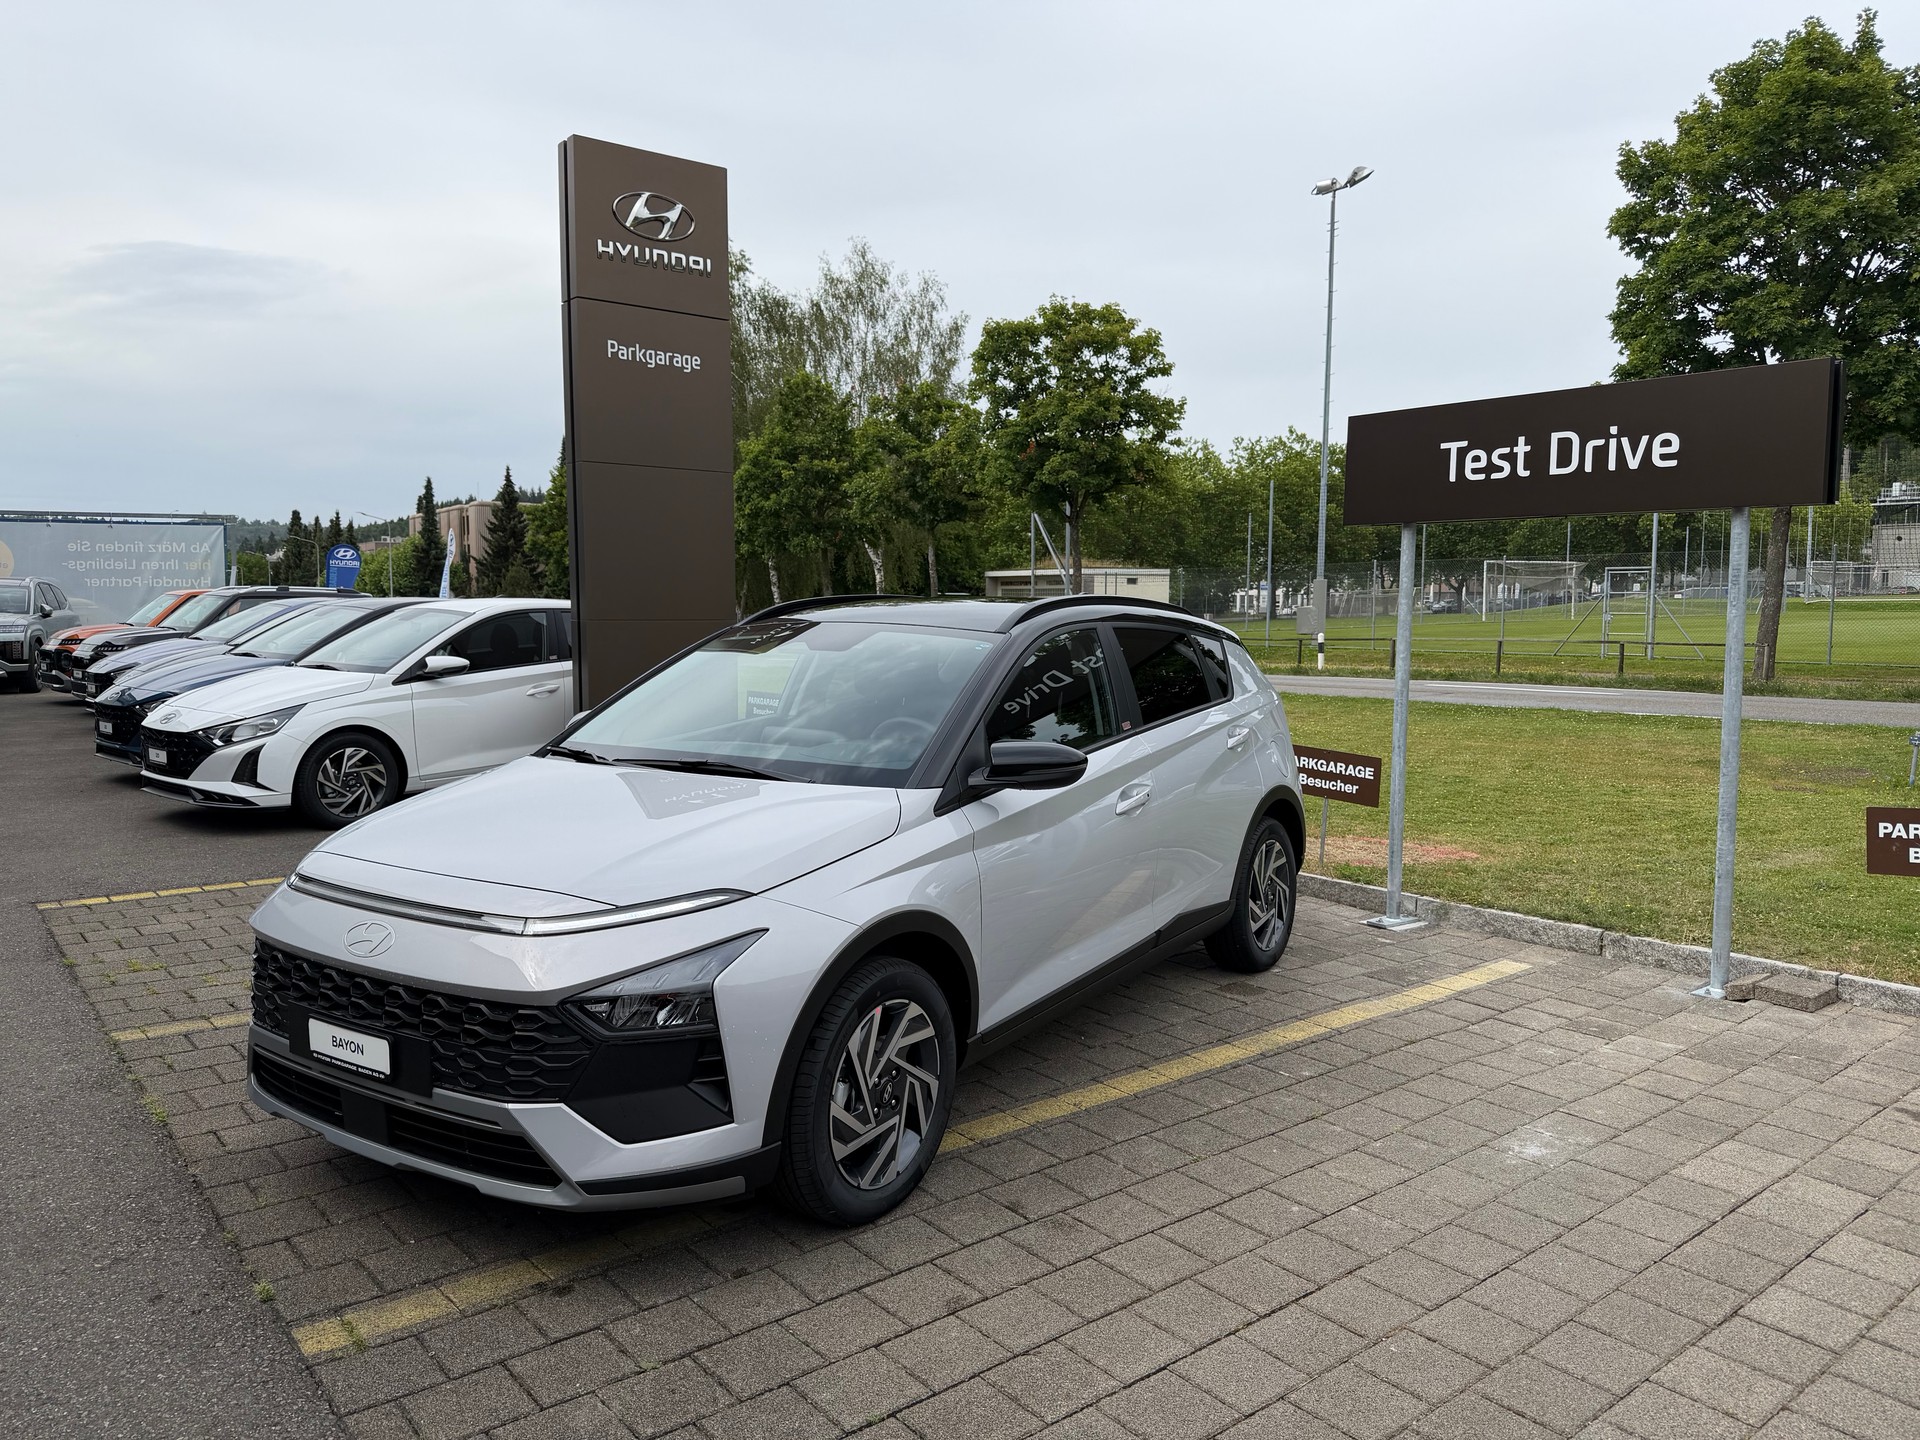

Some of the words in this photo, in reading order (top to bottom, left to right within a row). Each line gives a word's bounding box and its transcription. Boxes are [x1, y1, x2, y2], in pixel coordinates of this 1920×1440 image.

[596, 239, 712, 277] HYUNDAI
[607, 339, 701, 372] Parkgarage
[1440, 436, 1531, 482] Test
[1549, 425, 1680, 475] Drive
[1294, 755, 1375, 780] RKGARAGE
[1299, 773, 1359, 794] Besucher
[331, 1035, 364, 1056] BAYON
